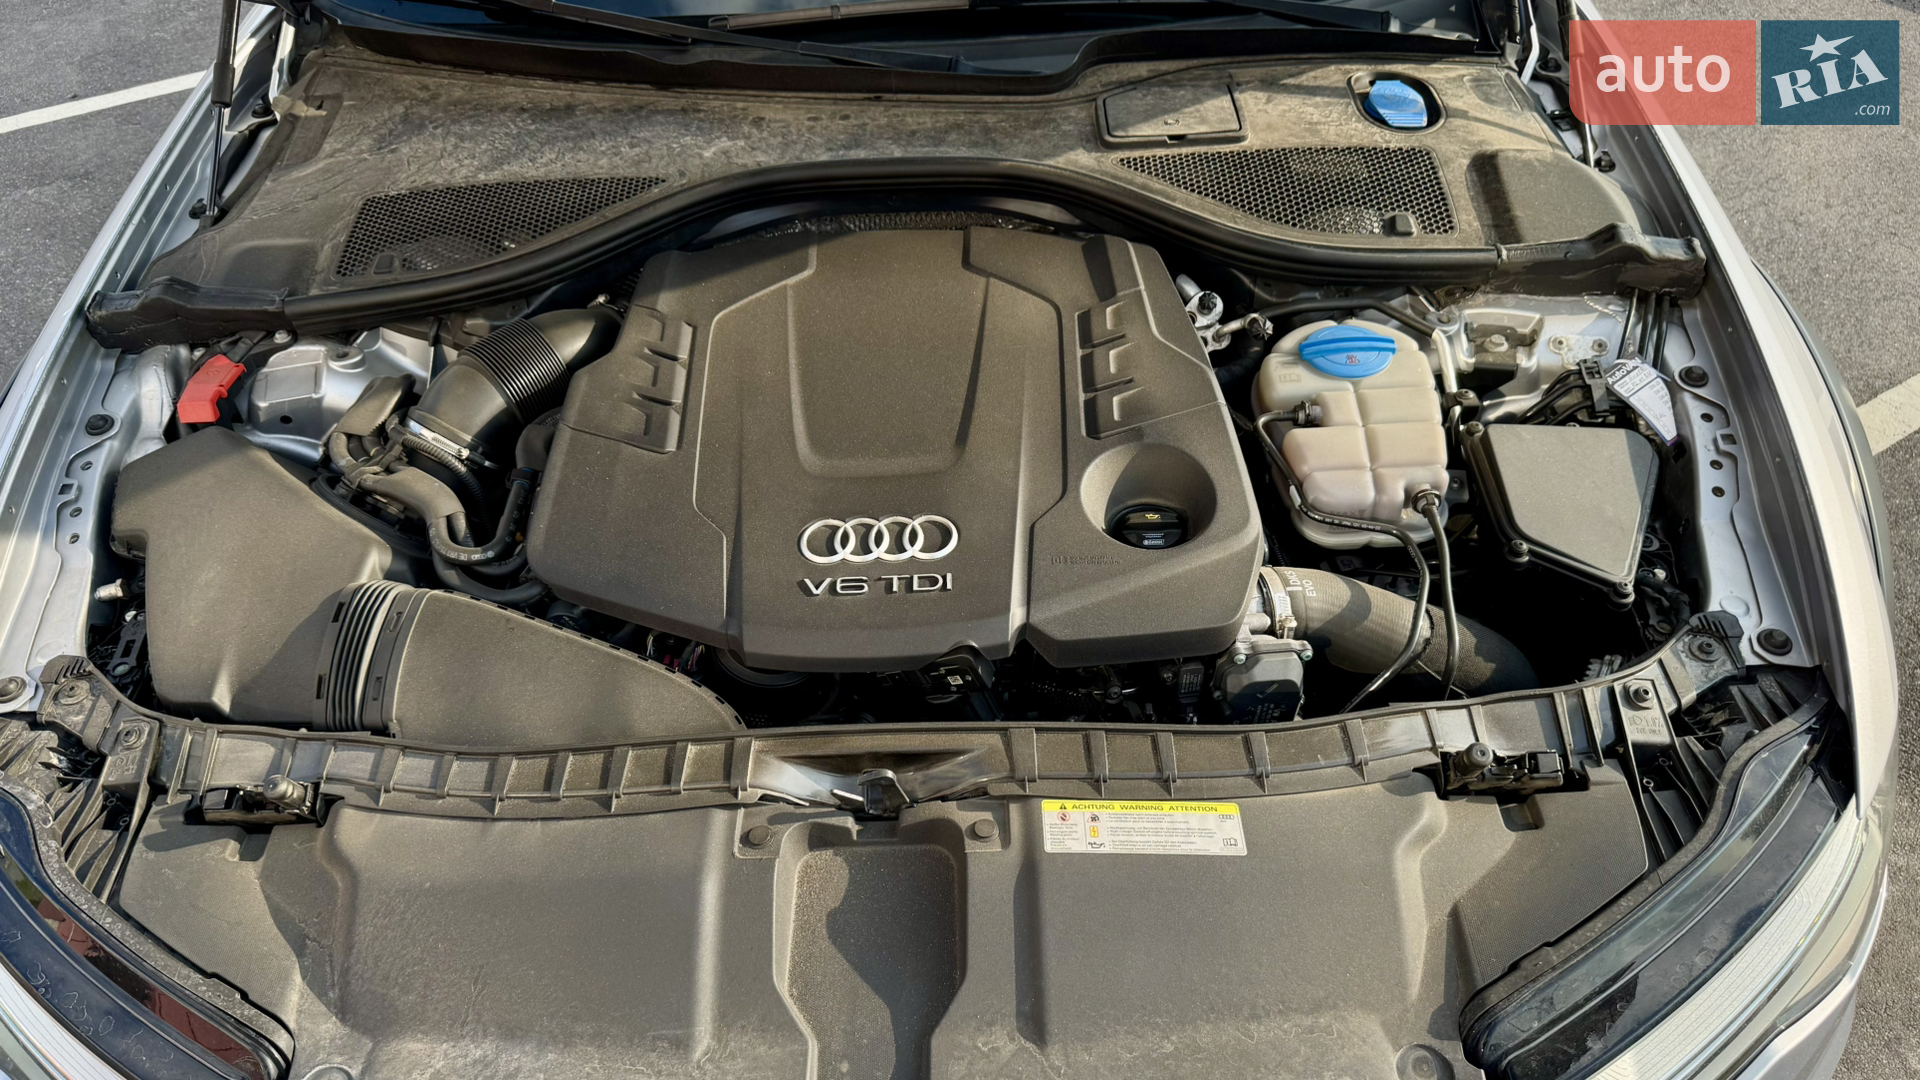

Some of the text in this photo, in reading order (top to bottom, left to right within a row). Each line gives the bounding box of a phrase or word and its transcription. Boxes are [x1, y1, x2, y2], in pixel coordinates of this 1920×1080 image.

[803, 572, 953, 595] V6 TDI
[1302, 579, 1317, 597] EVO
